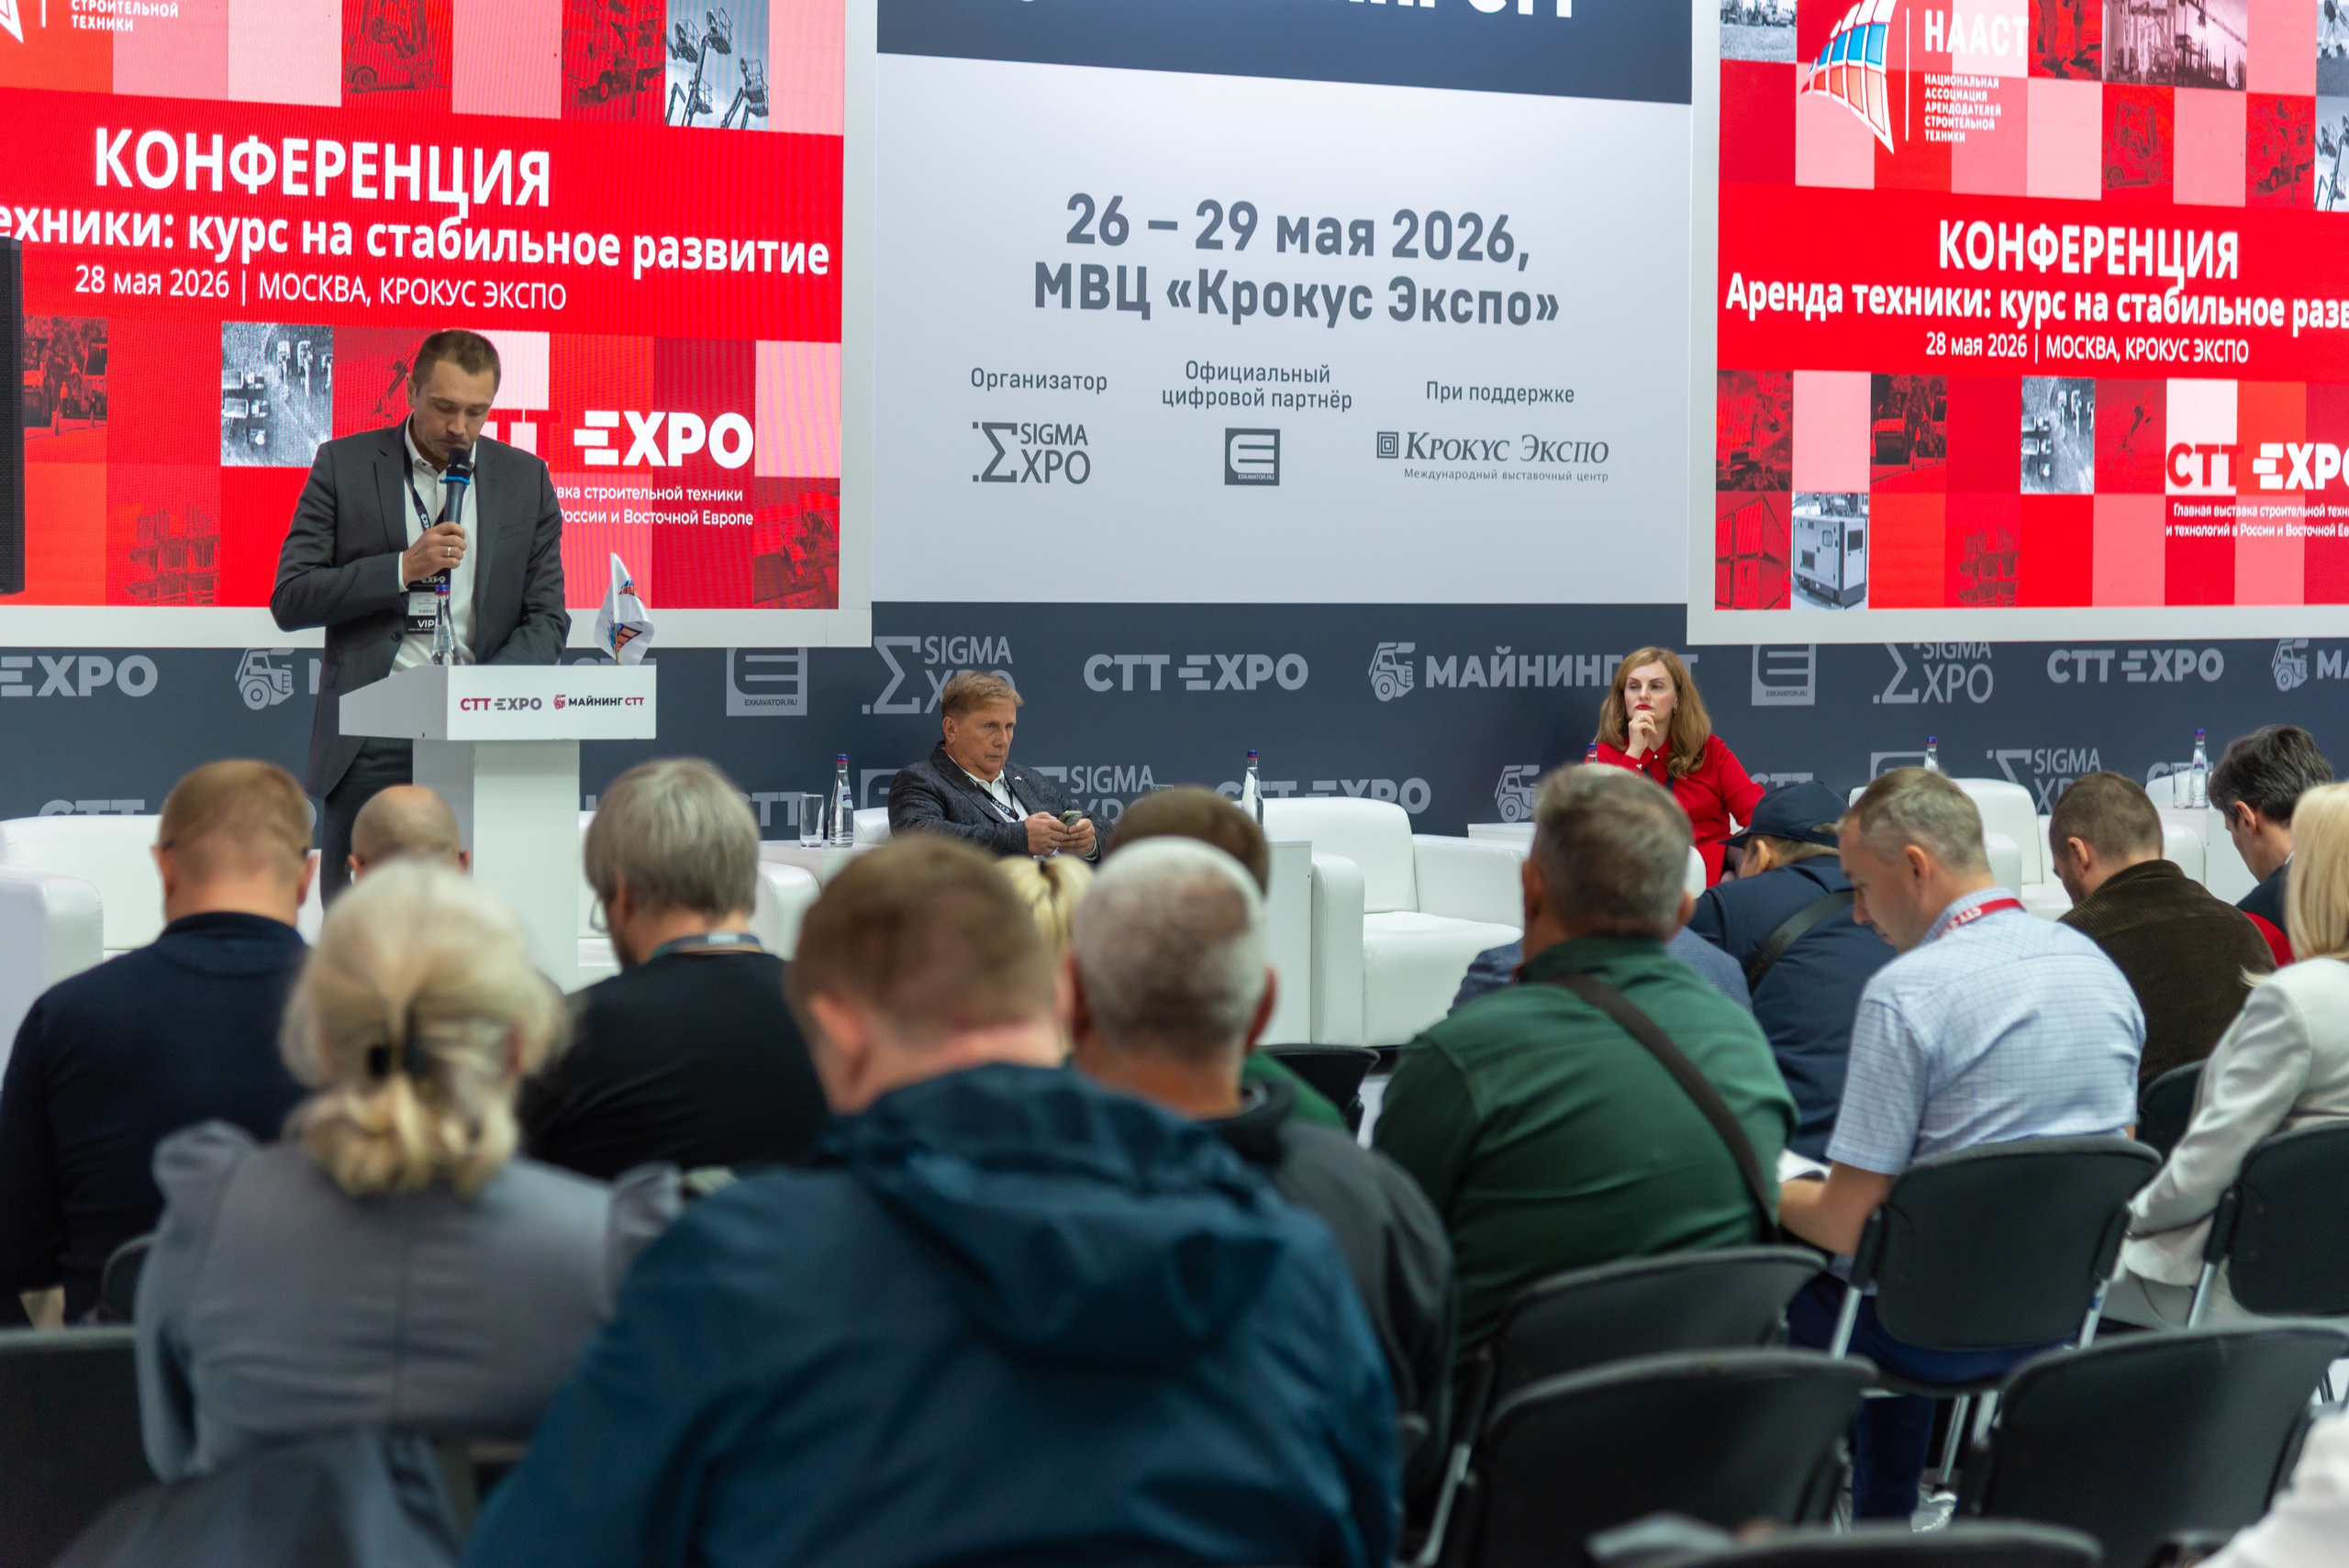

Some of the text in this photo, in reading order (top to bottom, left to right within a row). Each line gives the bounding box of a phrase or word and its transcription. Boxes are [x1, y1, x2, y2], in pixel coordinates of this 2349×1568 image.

[71, 0, 179, 17] СТРОИТЕЛЬНОЙ
[72, 15, 134, 32] ТЕХНИКИ
[1924, 9, 2030, 58] НААСТ
[1924, 73, 1999, 89] НАЦИОНАЛЬНАЯ
[1924, 87, 1987, 103] АССОЦИАЦИЯ
[1924, 101, 2002, 117] АРЕНДОДАТЕЛЕЙ
[1924, 116, 1996, 130] СТРОИТЕЛЬНОЙ
[1924, 129, 1965, 143] ТЕХНИКИ
[95, 128, 550, 218] КОНФЕРЕНЦИЯ
[1066, 193, 1130, 246] 26
[1196, 199, 1258, 250] 29
[1276, 216, 1375, 257] мая
[1392, 208, 1530, 272] 2026,
[189, 215, 288, 264] курс
[302, 220, 352, 255] на
[366, 217, 620, 266] стабильное
[634, 235, 829, 280] развитие
[1939, 219, 2239, 290] КОНФЕРЕНЦИЯ
[75, 264, 106, 293] 28
[114, 272, 161, 295] мая
[170, 269, 229, 298] 2026
[260, 272, 371, 306] МОСКВА,
[380, 277, 475, 306] КРОКУС
[483, 281, 566, 310] ЭКСПО
[1035, 261, 1559, 328] МВЦ «Крокус Экспо»
[1725, 272, 1843, 321] Аренда
[1852, 283, 1991, 318] техники:
[2000, 288, 2066, 329] курс
[2075, 291, 2109, 321] на
[2116, 286, 2285, 327] стабильное
[1926, 330, 1946, 355] 28
[1951, 336, 1983, 356] мая
[1987, 332, 2028, 358] 2026
[2046, 334, 2120, 363] МОСКВА,
[2126, 337, 2189, 361] КРОКУС
[2193, 338, 2248, 363] ЭКСПО
[971, 367, 1108, 395] Организатор
[1186, 360, 1330, 384] Официальный
[1162, 386, 1353, 413] цифровой партнёр
[1426, 381, 1575, 406] При поддержке
[573, 410, 754, 469] EXPO
[1020, 423, 1088, 446] SIGMA
[1404, 468, 1609, 483] Международный выставочный центр
[2166, 442, 2349, 490] CTT EXP
[584, 485, 683, 502] строительной
[686, 489, 743, 503] техники
[611, 512, 619, 523] и
[624, 509, 698, 525] Восточной
[703, 510, 754, 528] Европе
[2173, 502, 2211, 517] Главная
[2213, 506, 2258, 517] выставка
[2259, 503, 2325, 519] строительной
[2165, 526, 2173, 537] и
[2175, 522, 2231, 538] технологий
[2232, 527, 2238, 537] в
[2240, 523, 2275, 538] России
[2277, 525, 2284, 537] и
[2285, 522, 2336, 538] Восточной
[417, 619, 435, 628] VIP
[924, 636, 1013, 664] SIGMA
[1922, 642, 1992, 660] SIGMA
[1084, 652, 1309, 691] CTT EXPO
[1426, 645, 1623, 688] МАЙНИНГ
[2047, 648, 2224, 683] CTT EXPO
[460, 697, 542, 711] CTT EXPO
[568, 695, 644, 706] МАЙНИНГ СТТ
[744, 698, 797, 706] EXKAVATOR.RU
[2033, 747, 2102, 774] SIGMA
[1070, 764, 1155, 794] SIGMA
